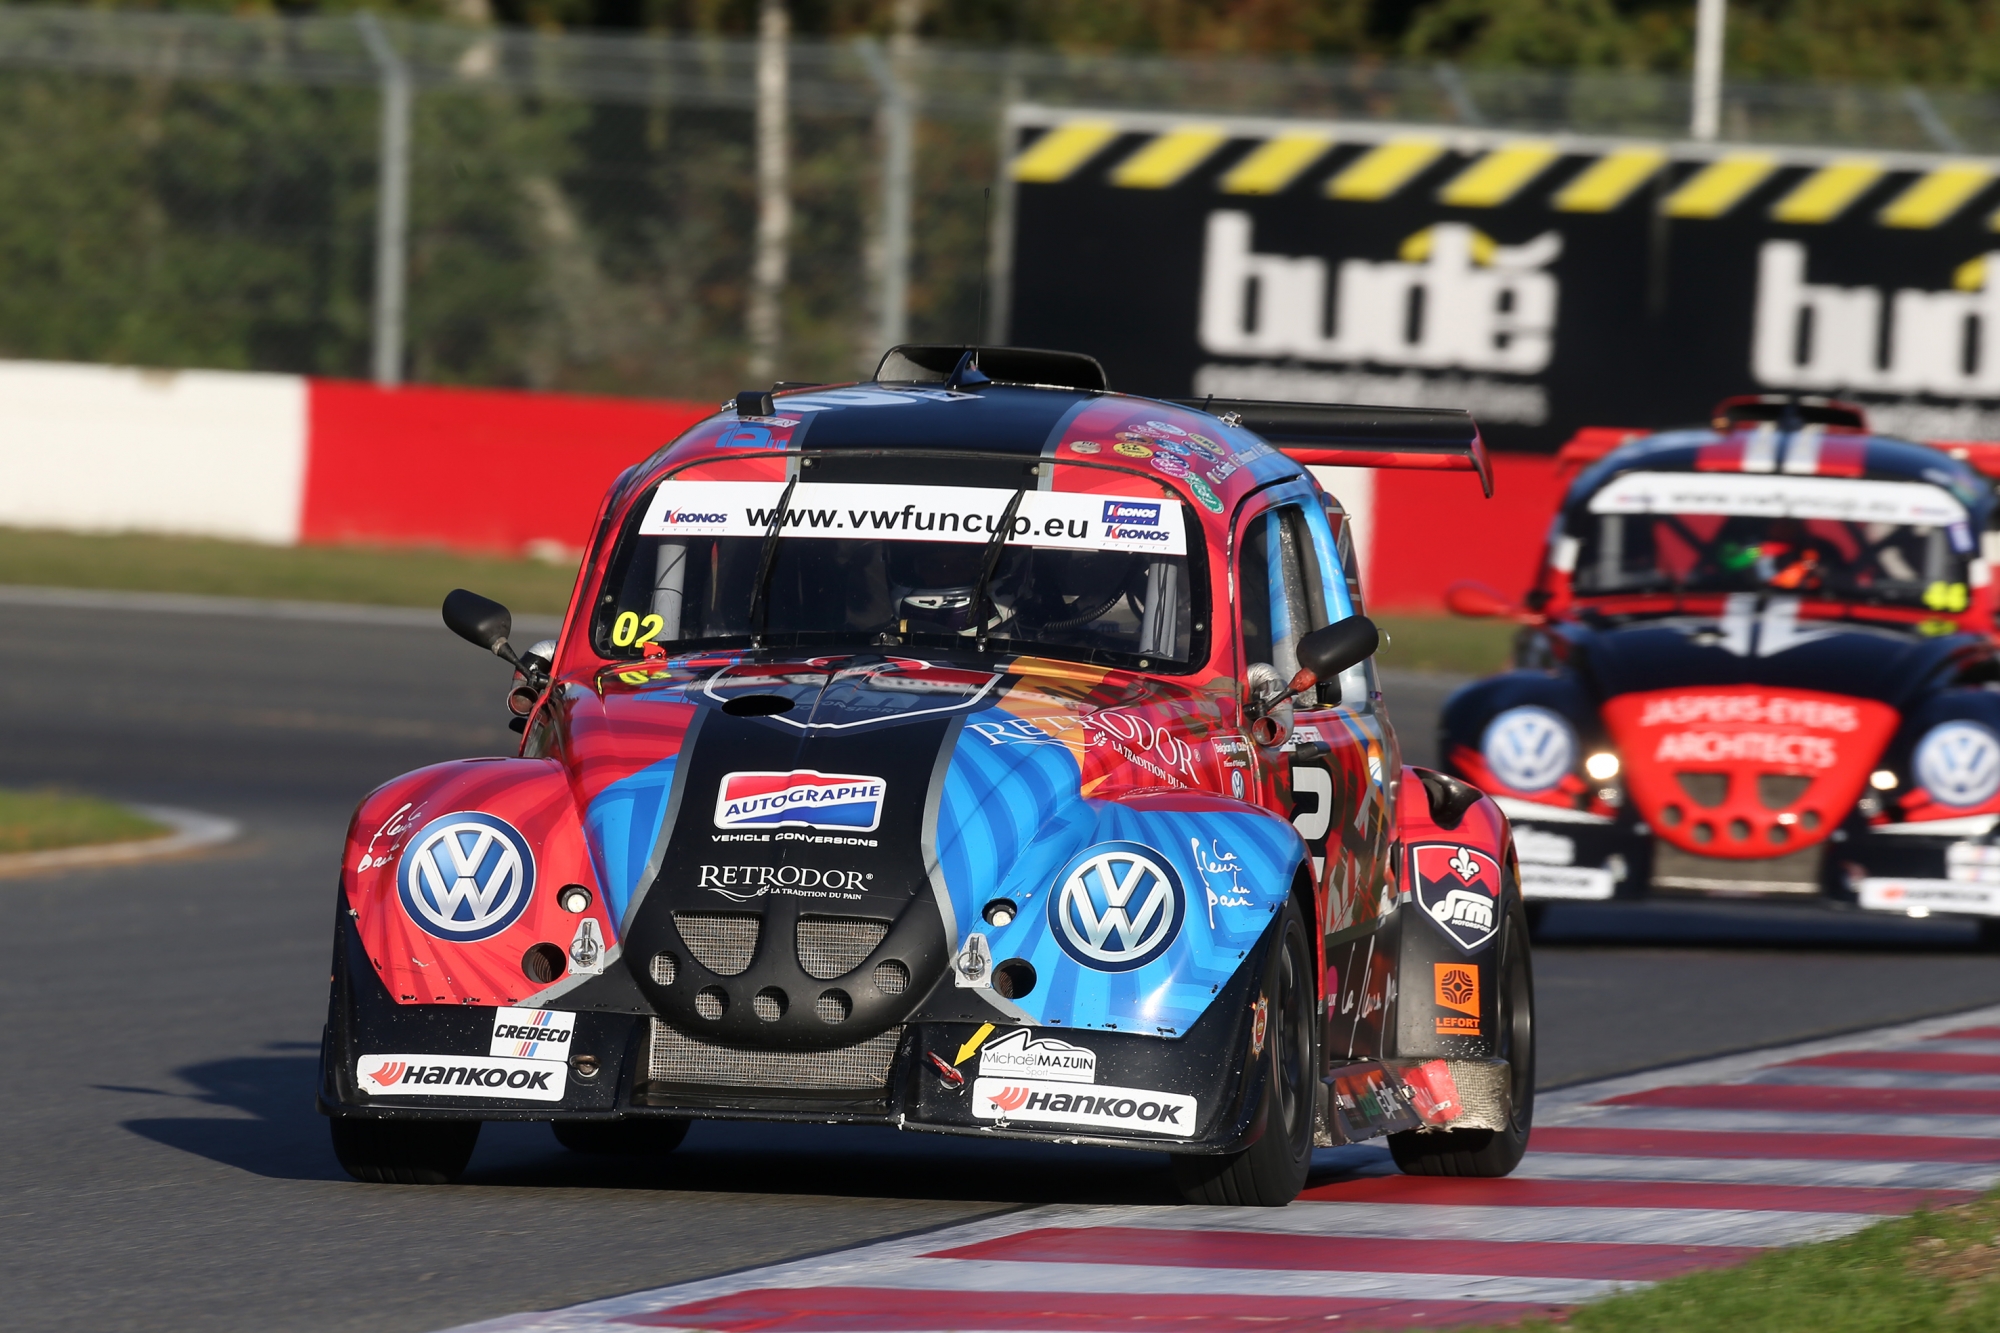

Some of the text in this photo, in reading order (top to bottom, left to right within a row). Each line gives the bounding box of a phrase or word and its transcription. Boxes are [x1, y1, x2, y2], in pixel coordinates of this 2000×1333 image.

[1202, 209, 1563, 375] budé
[1751, 238, 2000, 398] bud
[663, 506, 728, 524] KRONOS
[1107, 502, 1157, 519] KRONOS
[746, 504, 1089, 541] www.vwfuncup.eu
[1104, 523, 1170, 541] KRONOS
[612, 609, 665, 648] 02
[1112, 740, 1123, 755] LA
[1123, 746, 1167, 781] TRADITION
[725, 785, 881, 818] AUTOGRAPHE
[712, 832, 878, 848] VEHICLE CONVERSIONS
[782, 888, 827, 898] TRADITION
[828, 891, 842, 899] DU
[842, 892, 862, 900] PAIN
[1451, 918, 1492, 934] MOTORSPORT
[1436, 1017, 1480, 1028] LEFORT
[494, 1023, 571, 1043] CREDECO
[1025, 1064, 1049, 1078] Sport
